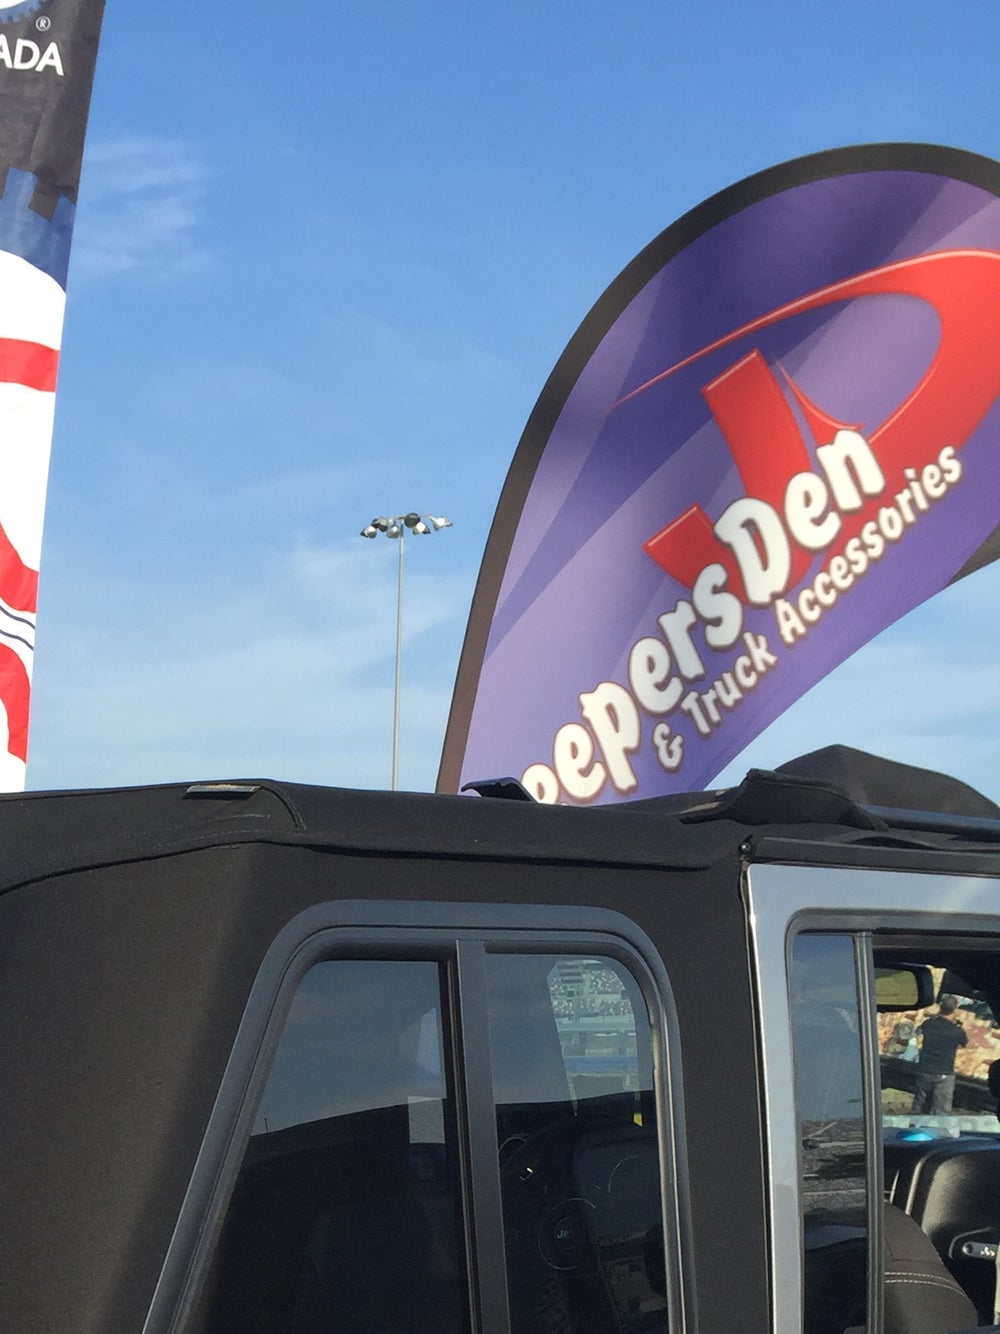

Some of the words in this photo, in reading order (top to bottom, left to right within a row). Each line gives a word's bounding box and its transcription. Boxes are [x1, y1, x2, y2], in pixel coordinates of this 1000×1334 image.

[653, 722, 685, 770] &
[682, 632, 775, 737] Truck
[775, 446, 963, 645] Accessories
